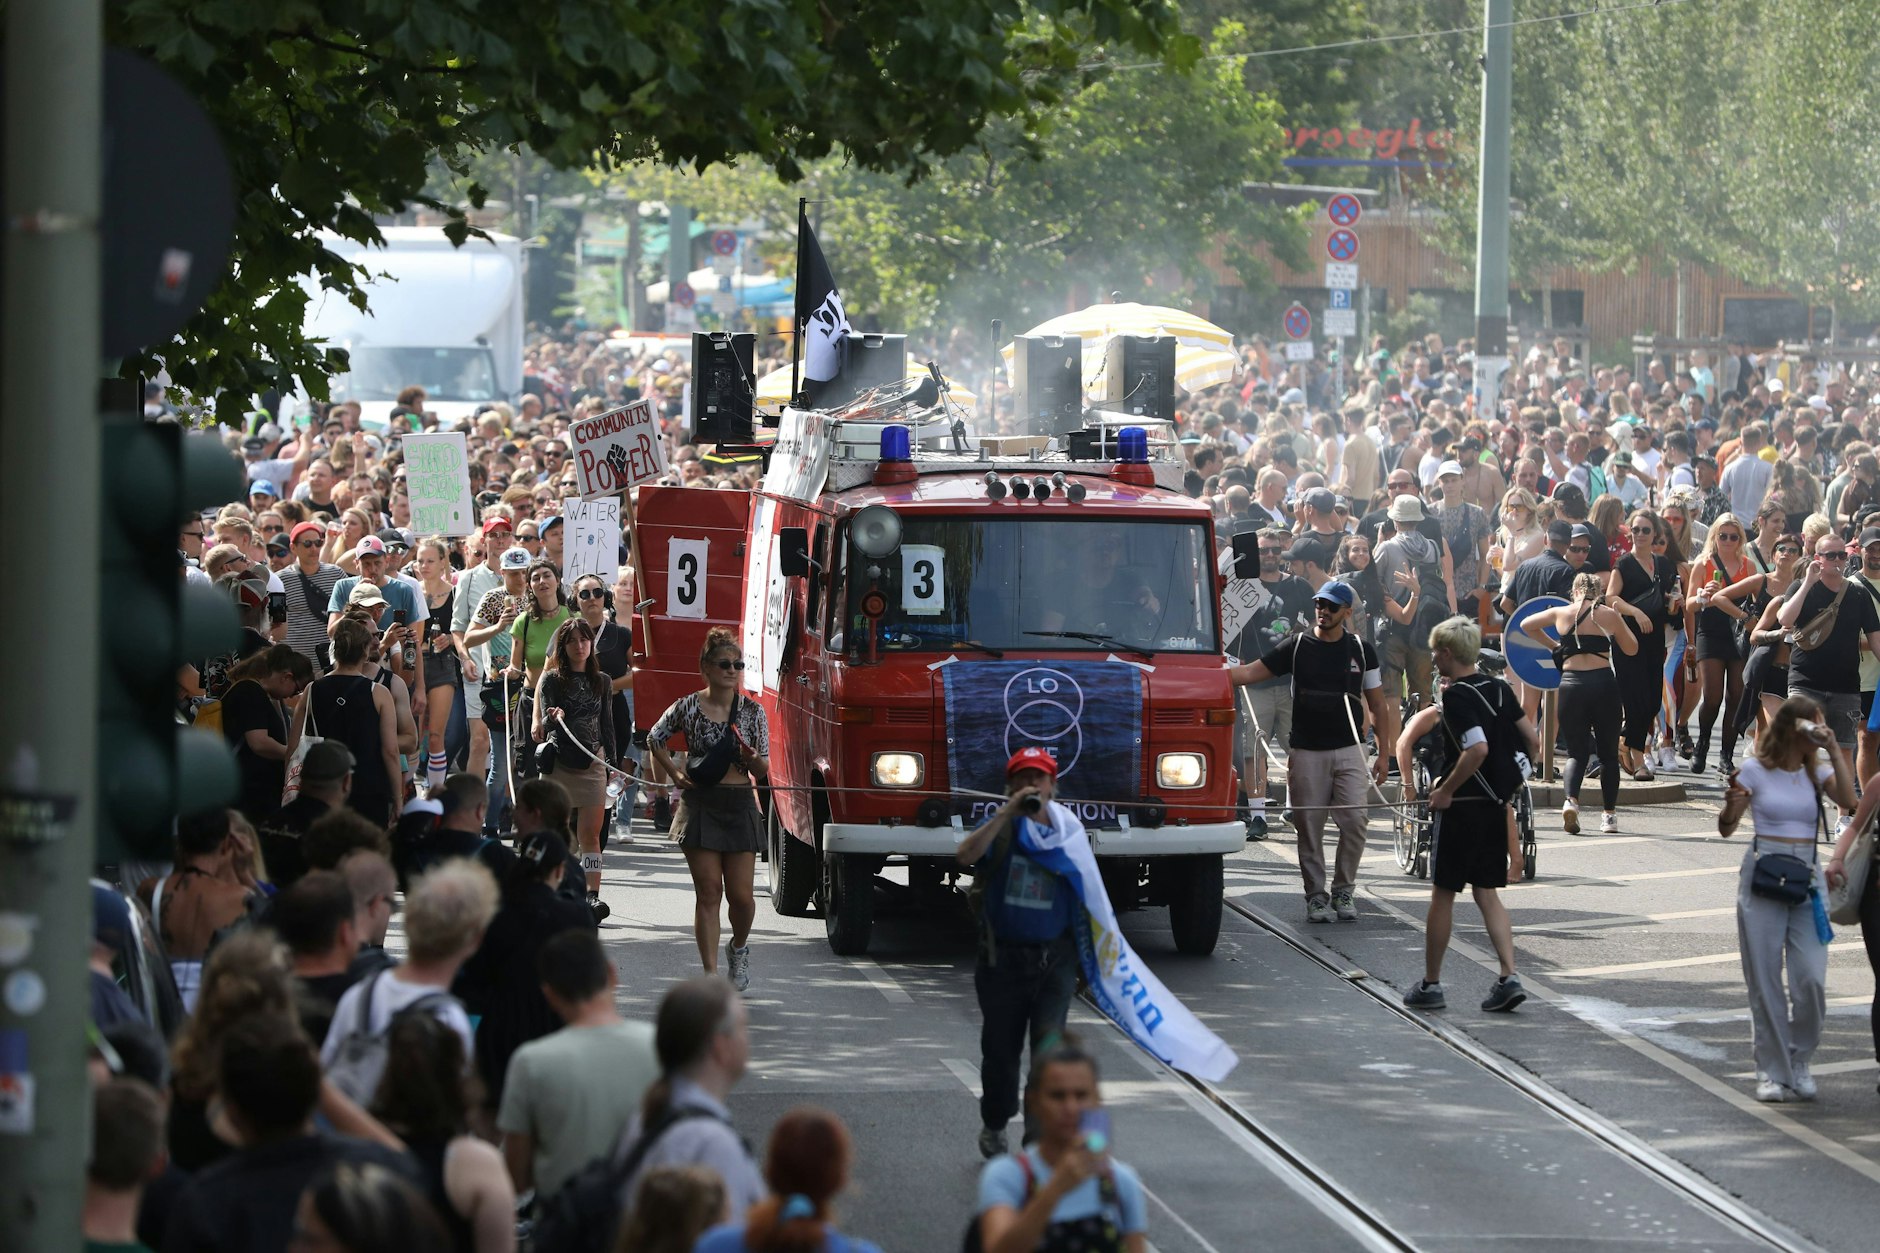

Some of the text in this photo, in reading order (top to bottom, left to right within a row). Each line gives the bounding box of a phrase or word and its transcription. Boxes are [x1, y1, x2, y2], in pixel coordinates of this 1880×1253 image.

[1334, 291, 1346, 307] P
[575, 404, 650, 444] COMMUNITY
[579, 433, 659, 495] POWER
[566, 501, 617, 523] WATER
[568, 551, 608, 579] ALL
[677, 553, 698, 605] 3
[912, 560, 935, 599] 3
[1027, 677, 1059, 694] LO
[1043, 746, 1059, 759] E
[970, 802, 1116, 821] FOTION
[584, 856, 603, 869] Ordn
